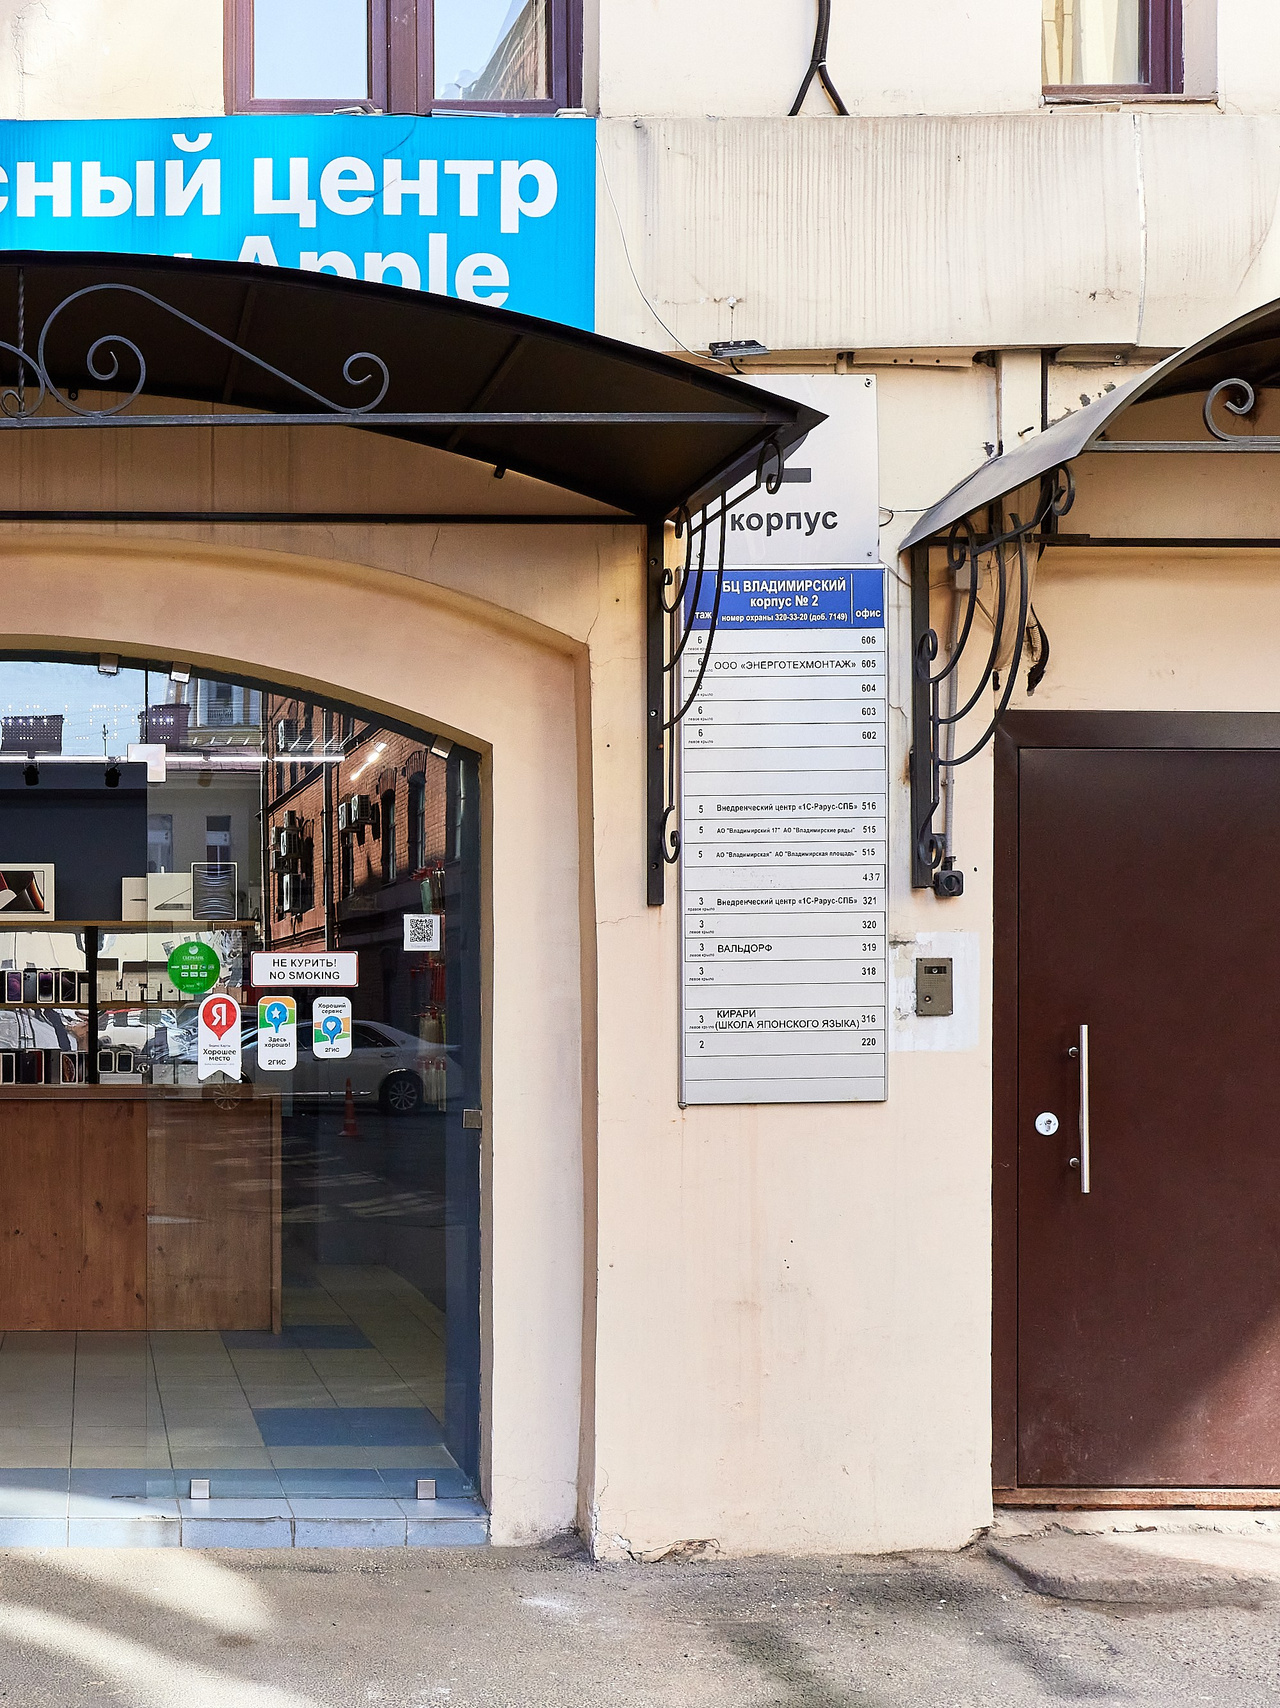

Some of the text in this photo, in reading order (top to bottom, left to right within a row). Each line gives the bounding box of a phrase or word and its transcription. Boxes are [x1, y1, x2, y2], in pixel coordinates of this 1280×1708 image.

[253, 154, 558, 234] центр
[730, 510, 838, 536] корпус
[722, 577, 846, 594] БЦ ВЛАДИМИРСКИЙ
[750, 595, 819, 609] корпус № 2
[695, 611, 713, 620] таж
[721, 615, 744, 623] номер
[746, 614, 774, 622] охраны
[775, 613, 807, 621] 320-33-20
[855, 608, 881, 619] офис
[697, 635, 877, 645] 6 606
[714, 661, 738, 670] ООО
[740, 660, 857, 671] «ЭНЕРГОТЕХМОНТАЖ»
[861, 660, 877, 668] 605
[861, 684, 877, 693] 604
[697, 706, 877, 716] 6 603
[698, 728, 877, 740] 6 602
[698, 805, 704, 814] 5
[716, 803, 774, 813] Внедренческий
[774, 803, 797, 813] центр
[861, 801, 877, 811] 516
[698, 826, 704, 834] 5
[862, 825, 877, 834] 515
[698, 850, 703, 859] 5
[862, 848, 876, 856] 515
[862, 872, 881, 882] 437
[698, 897, 704, 906] 3
[716, 897, 774, 907] Внедренческий
[774, 897, 797, 907] центр
[862, 896, 877, 905] 321
[699, 919, 877, 929] 3 320
[699, 942, 877, 954] 3 ВАЛЬДОРФ 319
[272, 958, 337, 967] НЕ КУРИТЬ!
[269, 971, 340, 980] NO SMOKING
[699, 966, 877, 976] 3 318
[716, 1009, 757, 1018] КИРАРИ
[861, 1014, 876, 1023] 316
[699, 1014, 704, 1024] 3
[715, 1019, 860, 1031] (ШКОЛА ЯПОНСКОГО ЯЗЫКА)
[699, 1037, 877, 1049] 2 220
[203, 1048, 237, 1056] Хорошее
